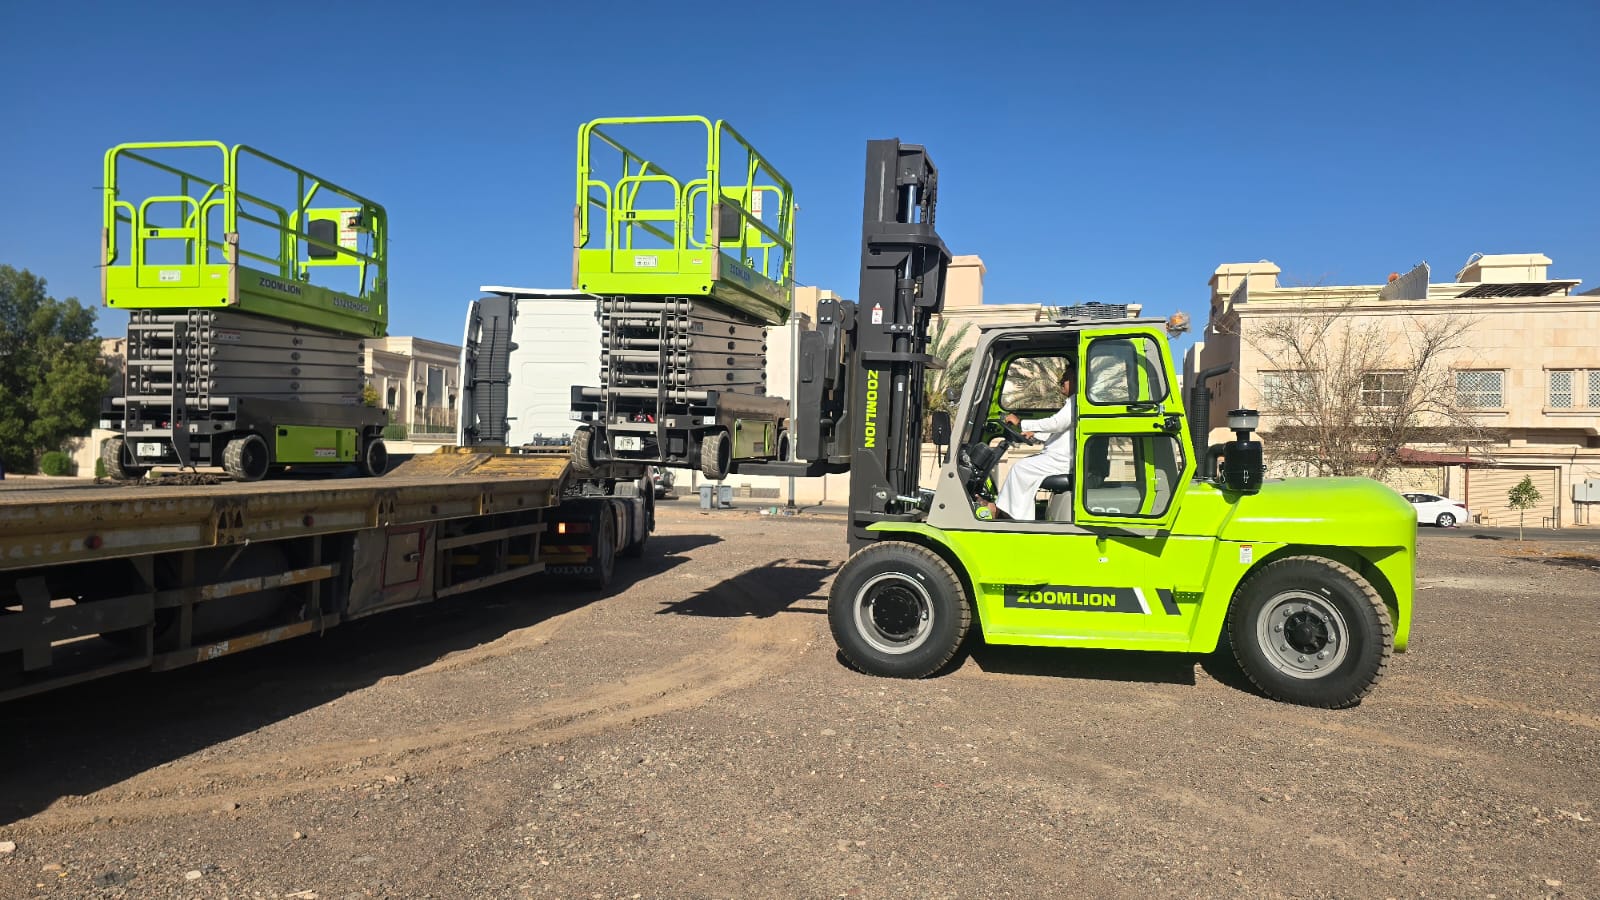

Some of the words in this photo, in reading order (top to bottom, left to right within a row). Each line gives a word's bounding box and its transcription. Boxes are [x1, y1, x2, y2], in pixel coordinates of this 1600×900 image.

[259, 277, 301, 295] ZOOMLION
[864, 369, 879, 448] ZOOMLION
[544, 565, 593, 575] VOLVO
[1016, 590, 1116, 607] ZOOMLION
